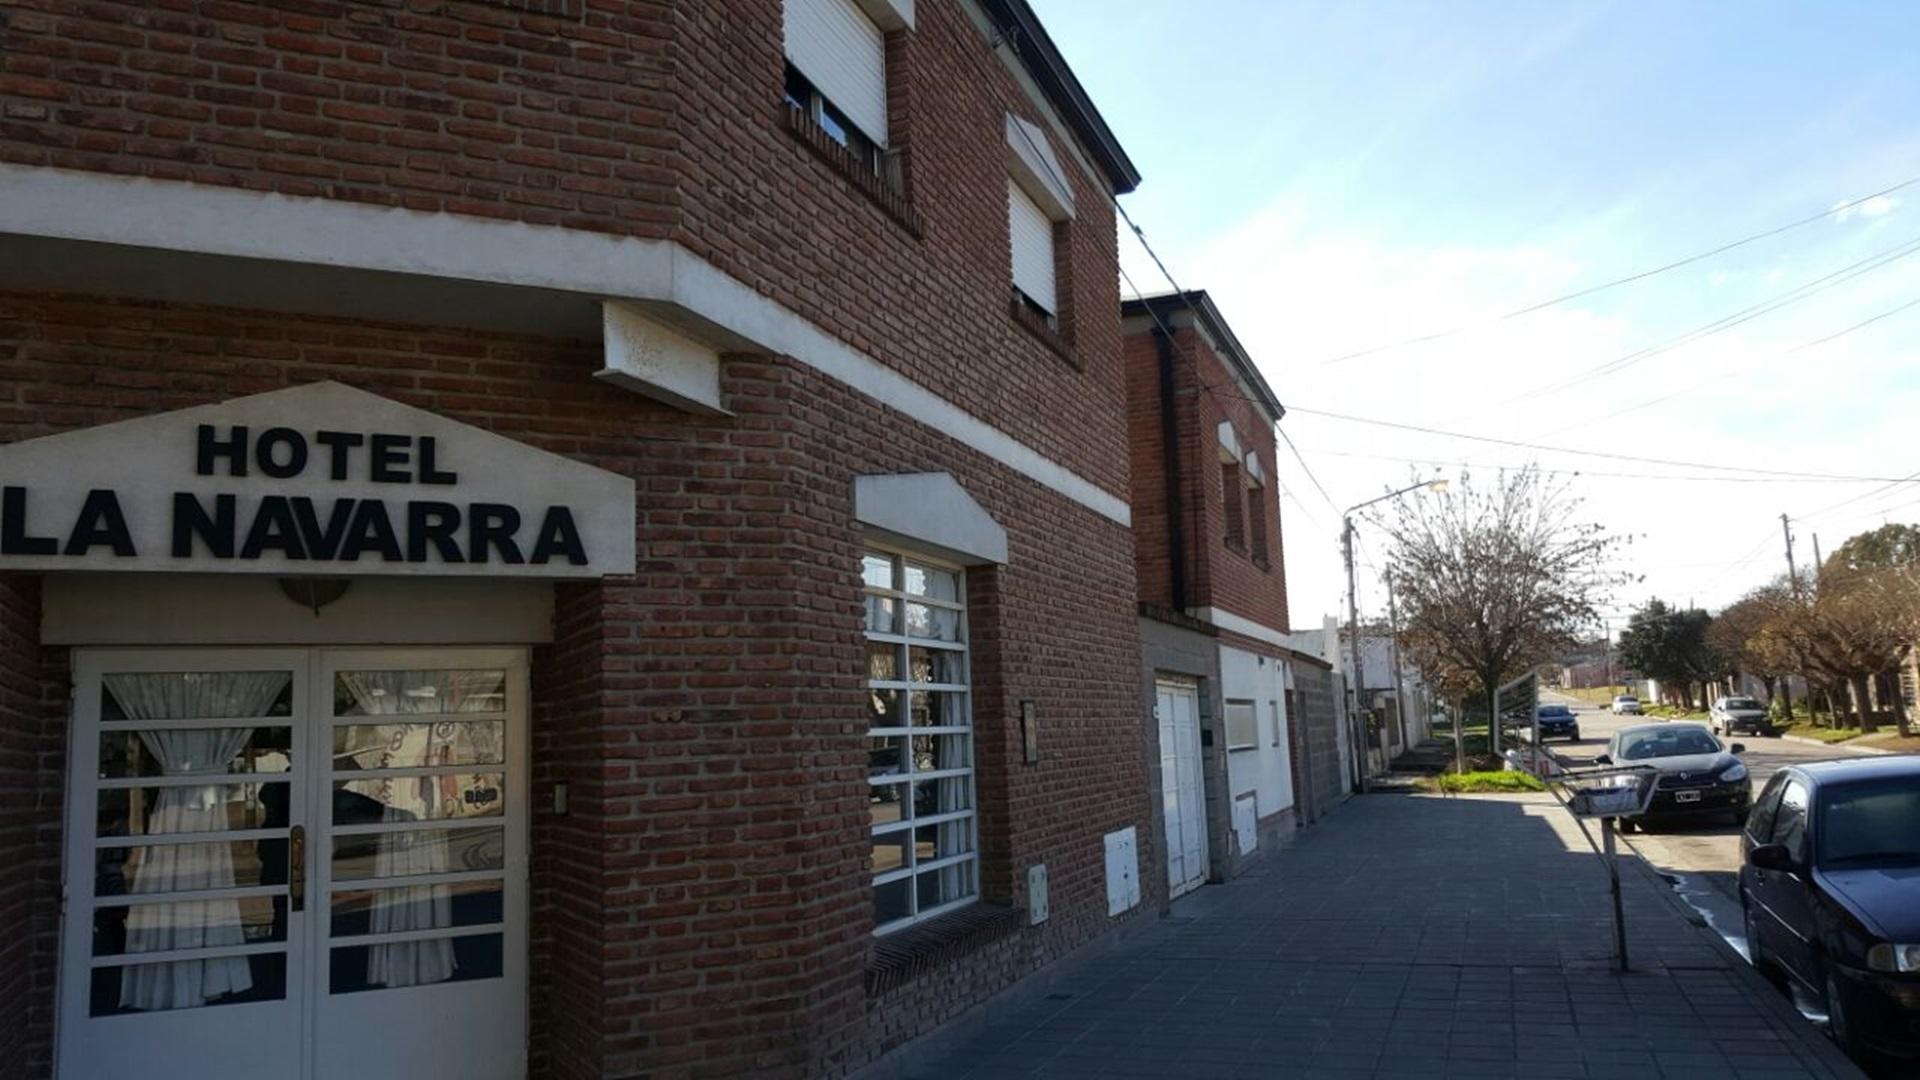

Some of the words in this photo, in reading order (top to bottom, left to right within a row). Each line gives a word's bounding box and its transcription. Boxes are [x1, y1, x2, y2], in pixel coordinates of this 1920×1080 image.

[195, 424, 458, 485] HOTEL
[1, 486, 137, 556] LA
[172, 491, 589, 565] NAVARRA
